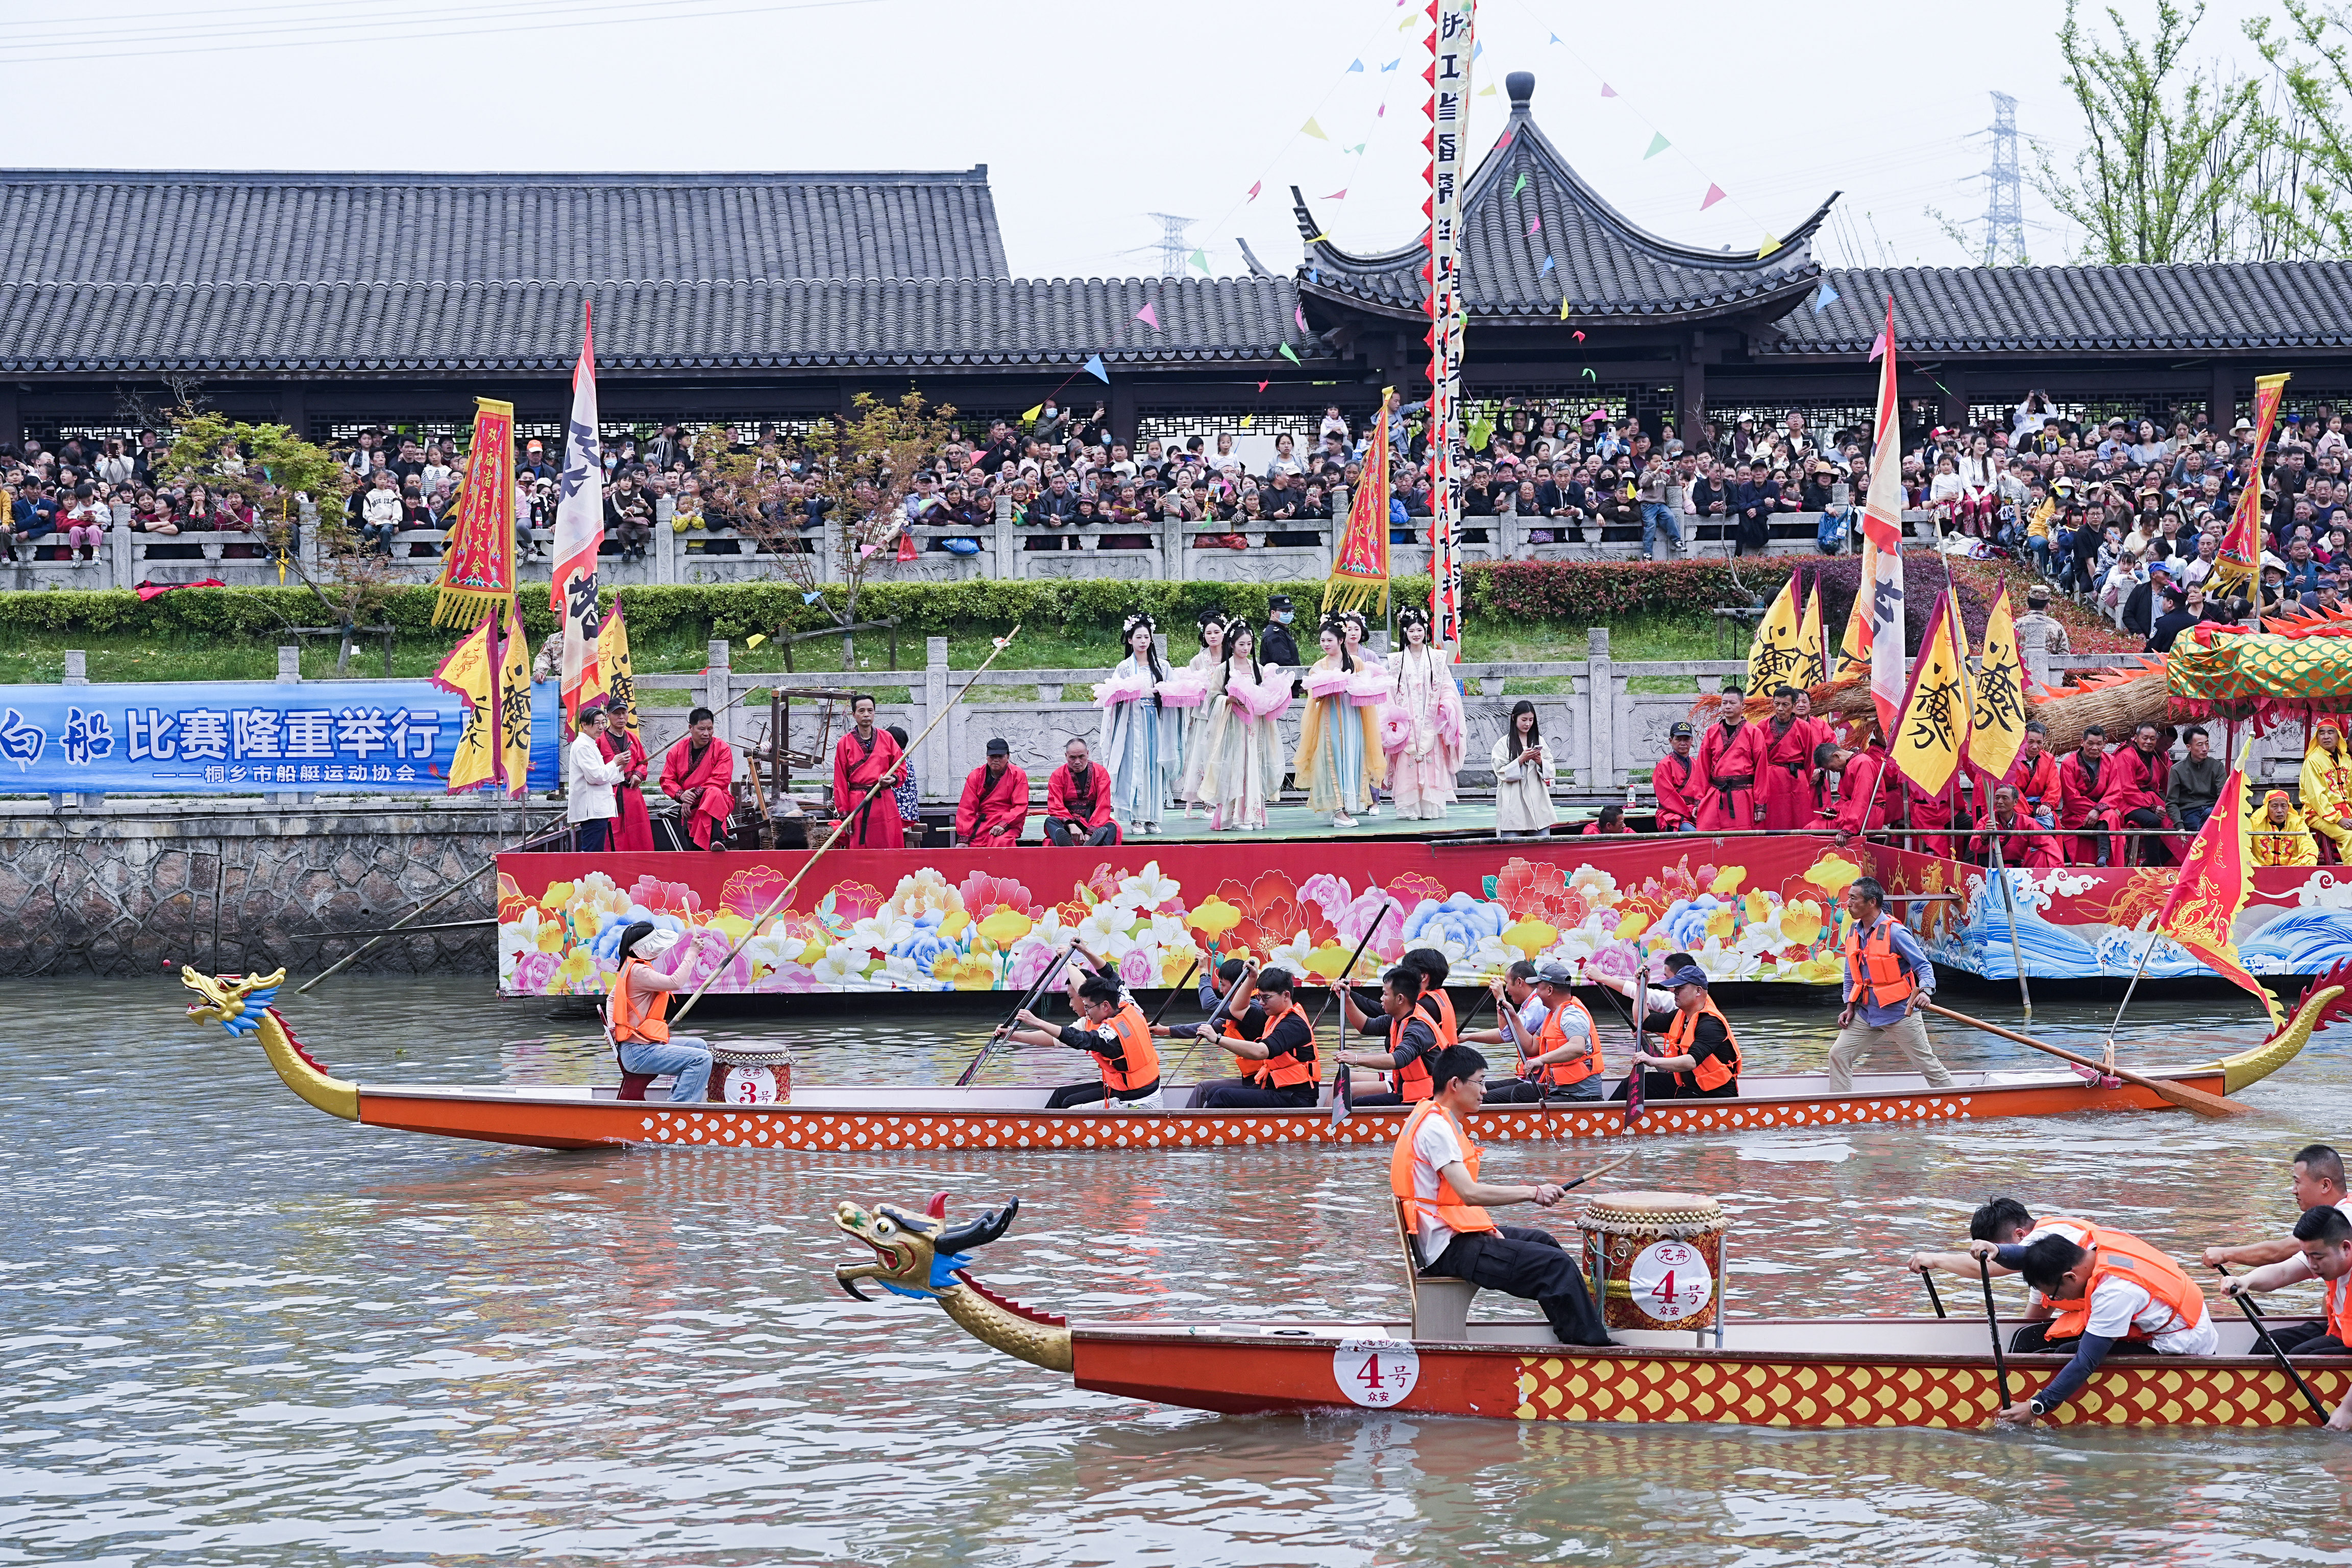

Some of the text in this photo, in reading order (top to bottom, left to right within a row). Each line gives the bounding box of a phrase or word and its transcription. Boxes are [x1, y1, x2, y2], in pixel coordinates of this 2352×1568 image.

[469, 428, 497, 573] 双庙渚蚕花水会
[743, 1068, 762, 1077] 龙舟
[1660, 1248, 1687, 1261] 龙舟
[1659, 1306, 1679, 1316] 众安
[1367, 1391, 1389, 1402] 众安
